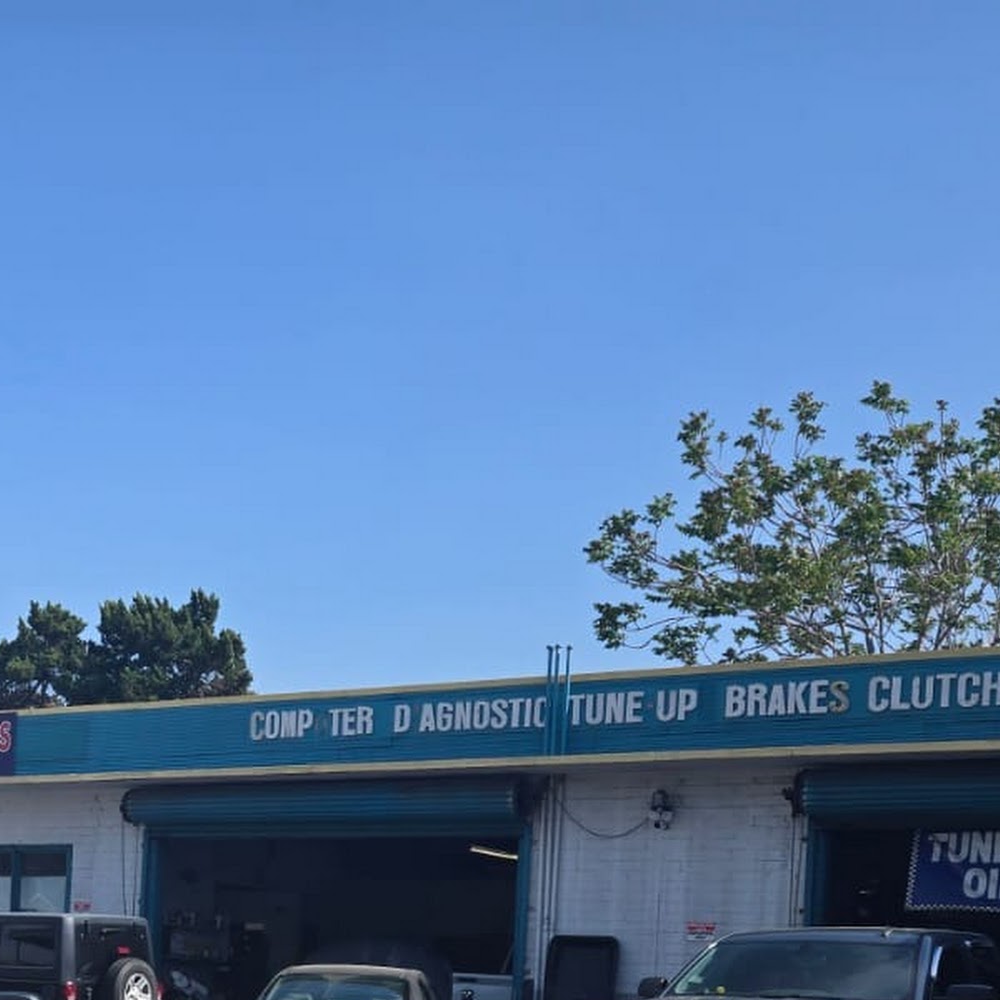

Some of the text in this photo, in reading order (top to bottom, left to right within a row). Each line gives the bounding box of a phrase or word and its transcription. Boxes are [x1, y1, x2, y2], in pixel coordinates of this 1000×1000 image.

[569, 691, 645, 725] TUNE
[656, 688, 698, 722] UP
[724, 679, 850, 718] BRAKES
